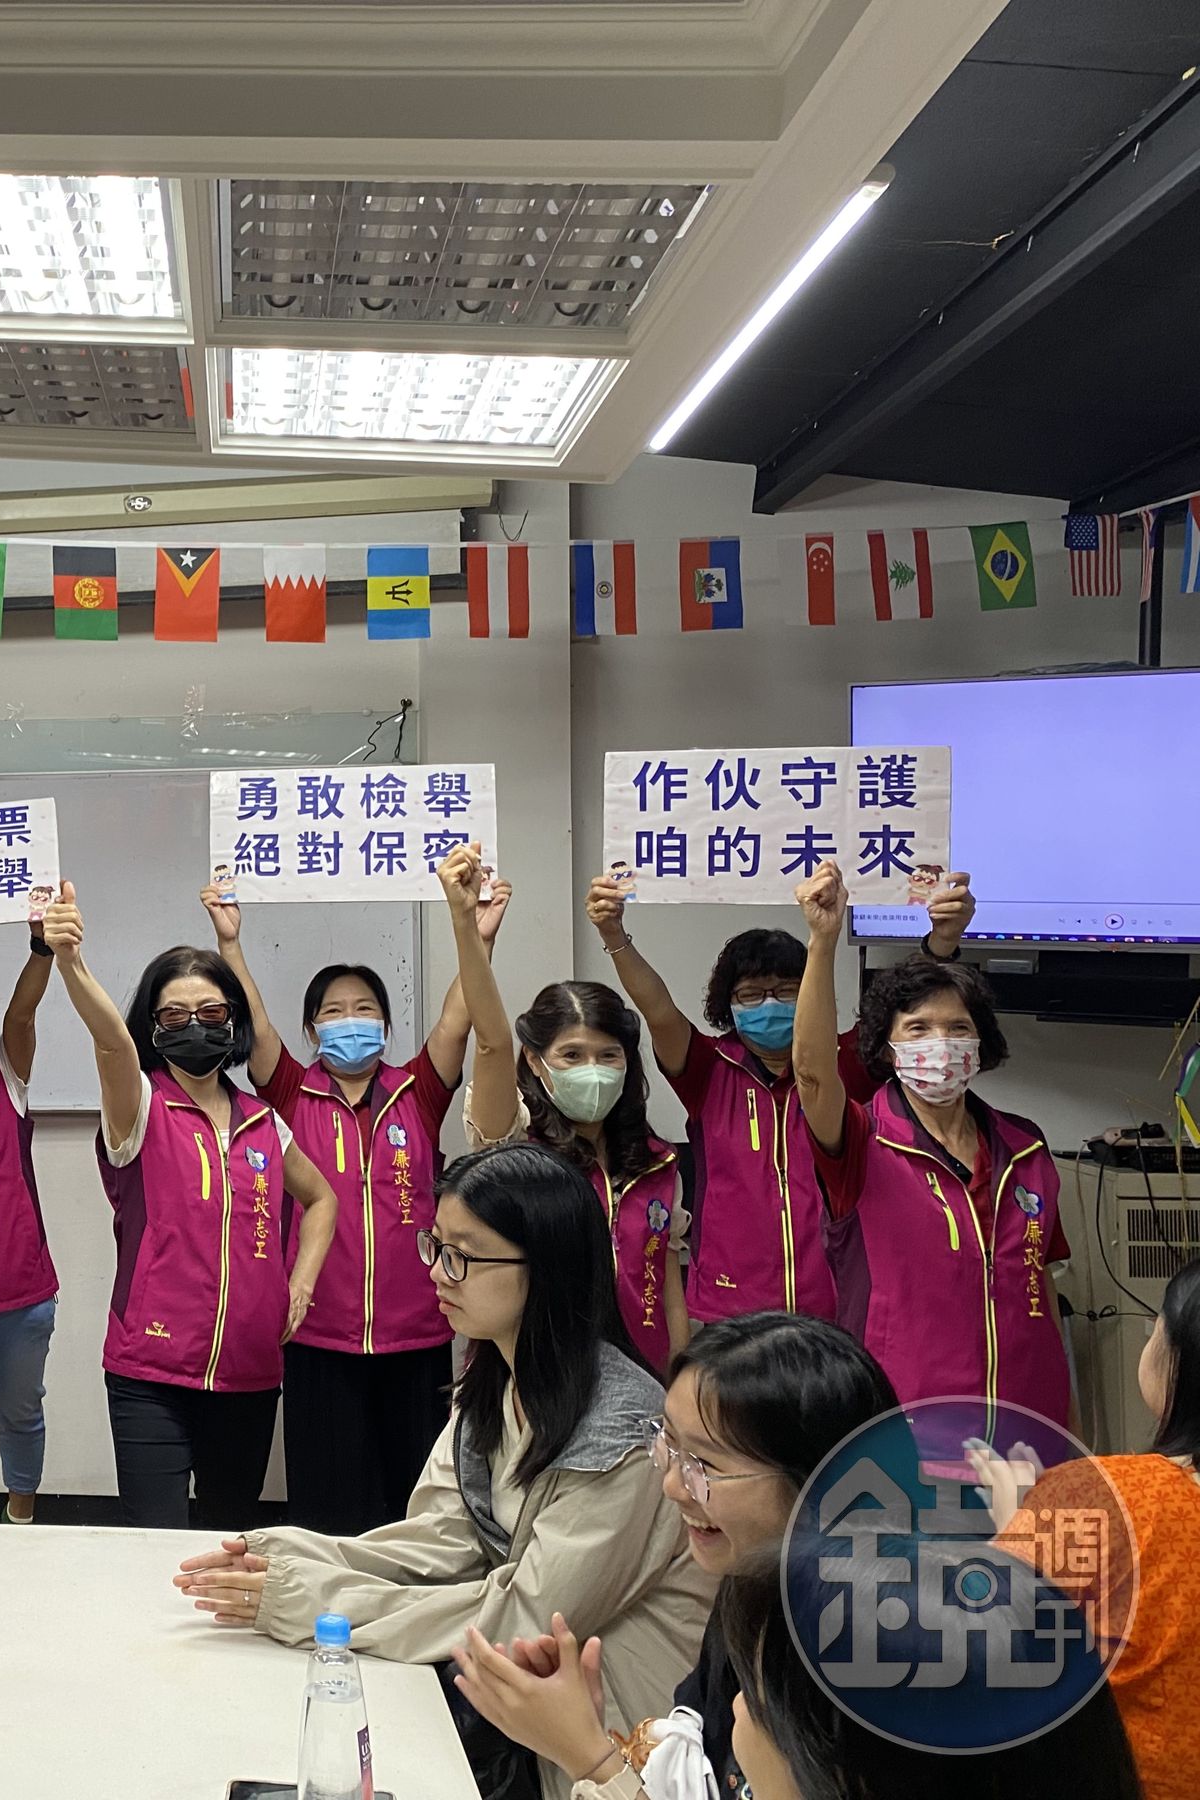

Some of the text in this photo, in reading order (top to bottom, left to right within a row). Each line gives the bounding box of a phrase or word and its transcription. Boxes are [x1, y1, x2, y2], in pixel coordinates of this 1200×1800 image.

[236, 772, 471, 821] 勇敢檢舉
[632, 754, 918, 812] 作伙守護
[234, 829, 469, 877] 絕對保密
[635, 824, 917, 878] 咱的未來
[252, 1172, 271, 1259] 廉政志工
[392, 1149, 414, 1224] 廉政志工
[1023, 1219, 1044, 1317] 廉政志工
